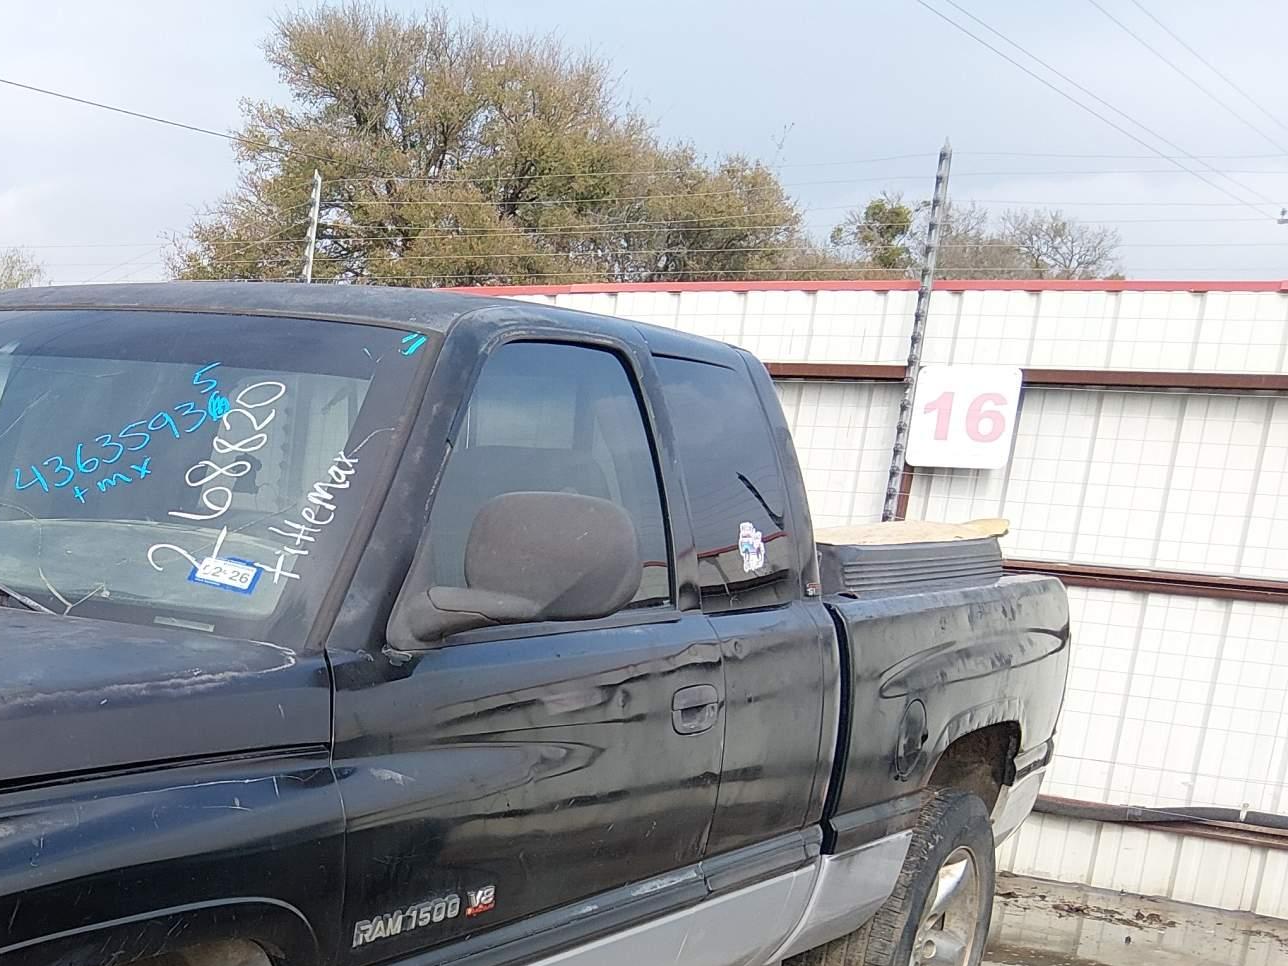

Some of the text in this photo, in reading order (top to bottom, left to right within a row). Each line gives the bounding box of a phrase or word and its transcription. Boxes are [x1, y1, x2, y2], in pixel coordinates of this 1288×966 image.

[923, 391, 1008, 443] 16
[352, 911, 403, 948] RAM
[403, 894, 461, 930] 1500
[466, 885, 496, 908] V8
